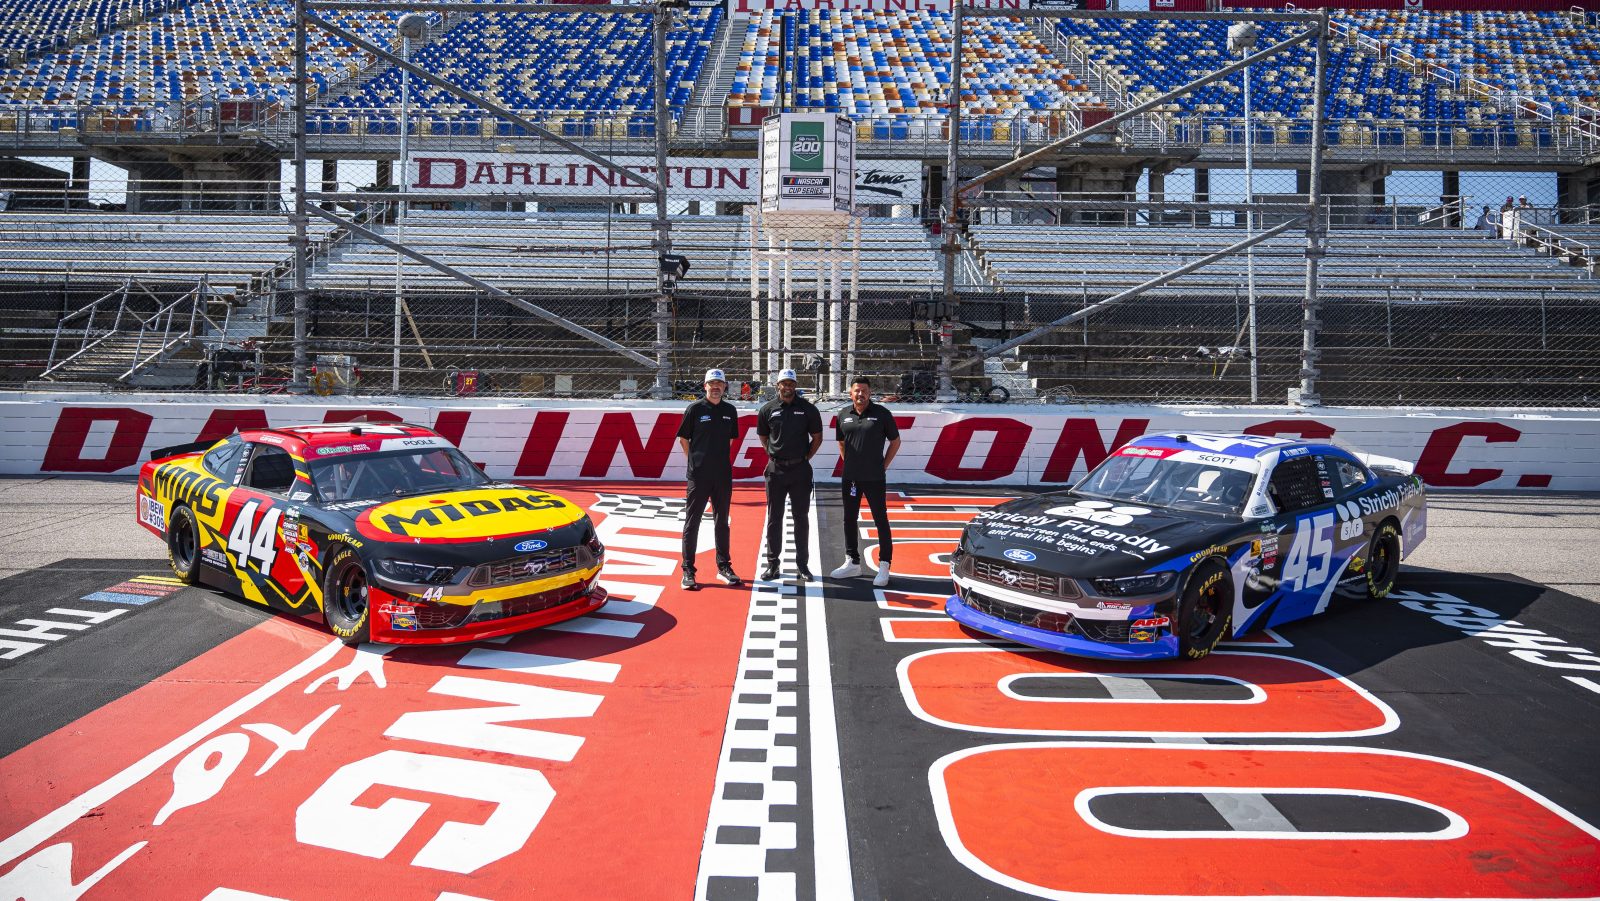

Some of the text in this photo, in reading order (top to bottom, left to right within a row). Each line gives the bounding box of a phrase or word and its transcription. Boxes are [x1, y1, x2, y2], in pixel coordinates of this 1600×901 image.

[792, 141, 821, 153] 200
[797, 178, 824, 186] NASCAR
[802, 187, 824, 195] SERIES
[403, 438, 436, 447] POOLE
[1199, 454, 1235, 465] SCOTT
[154, 463, 229, 518] MIDAS
[148, 499, 165, 517] IBEW
[1358, 489, 1401, 516] Strictly
[149, 511, 165, 530] #309
[380, 494, 566, 537] MIDAS
[227, 500, 282, 576] 44
[327, 532, 363, 548] GOODYEAR
[974, 510, 1171, 555] Strictly Friendly
[986, 521, 1118, 552] Where screen time ends
[988, 528, 1097, 556] and real life begins
[333, 549, 352, 566] EAGLE
[1190, 544, 1228, 563] GOODYEAR
[1282, 513, 1335, 592] 45
[1199, 571, 1224, 597] EAGLE
[422, 586, 444, 601] 44
[379, 604, 415, 614] ARP
[1130, 617, 1170, 627] ARP
